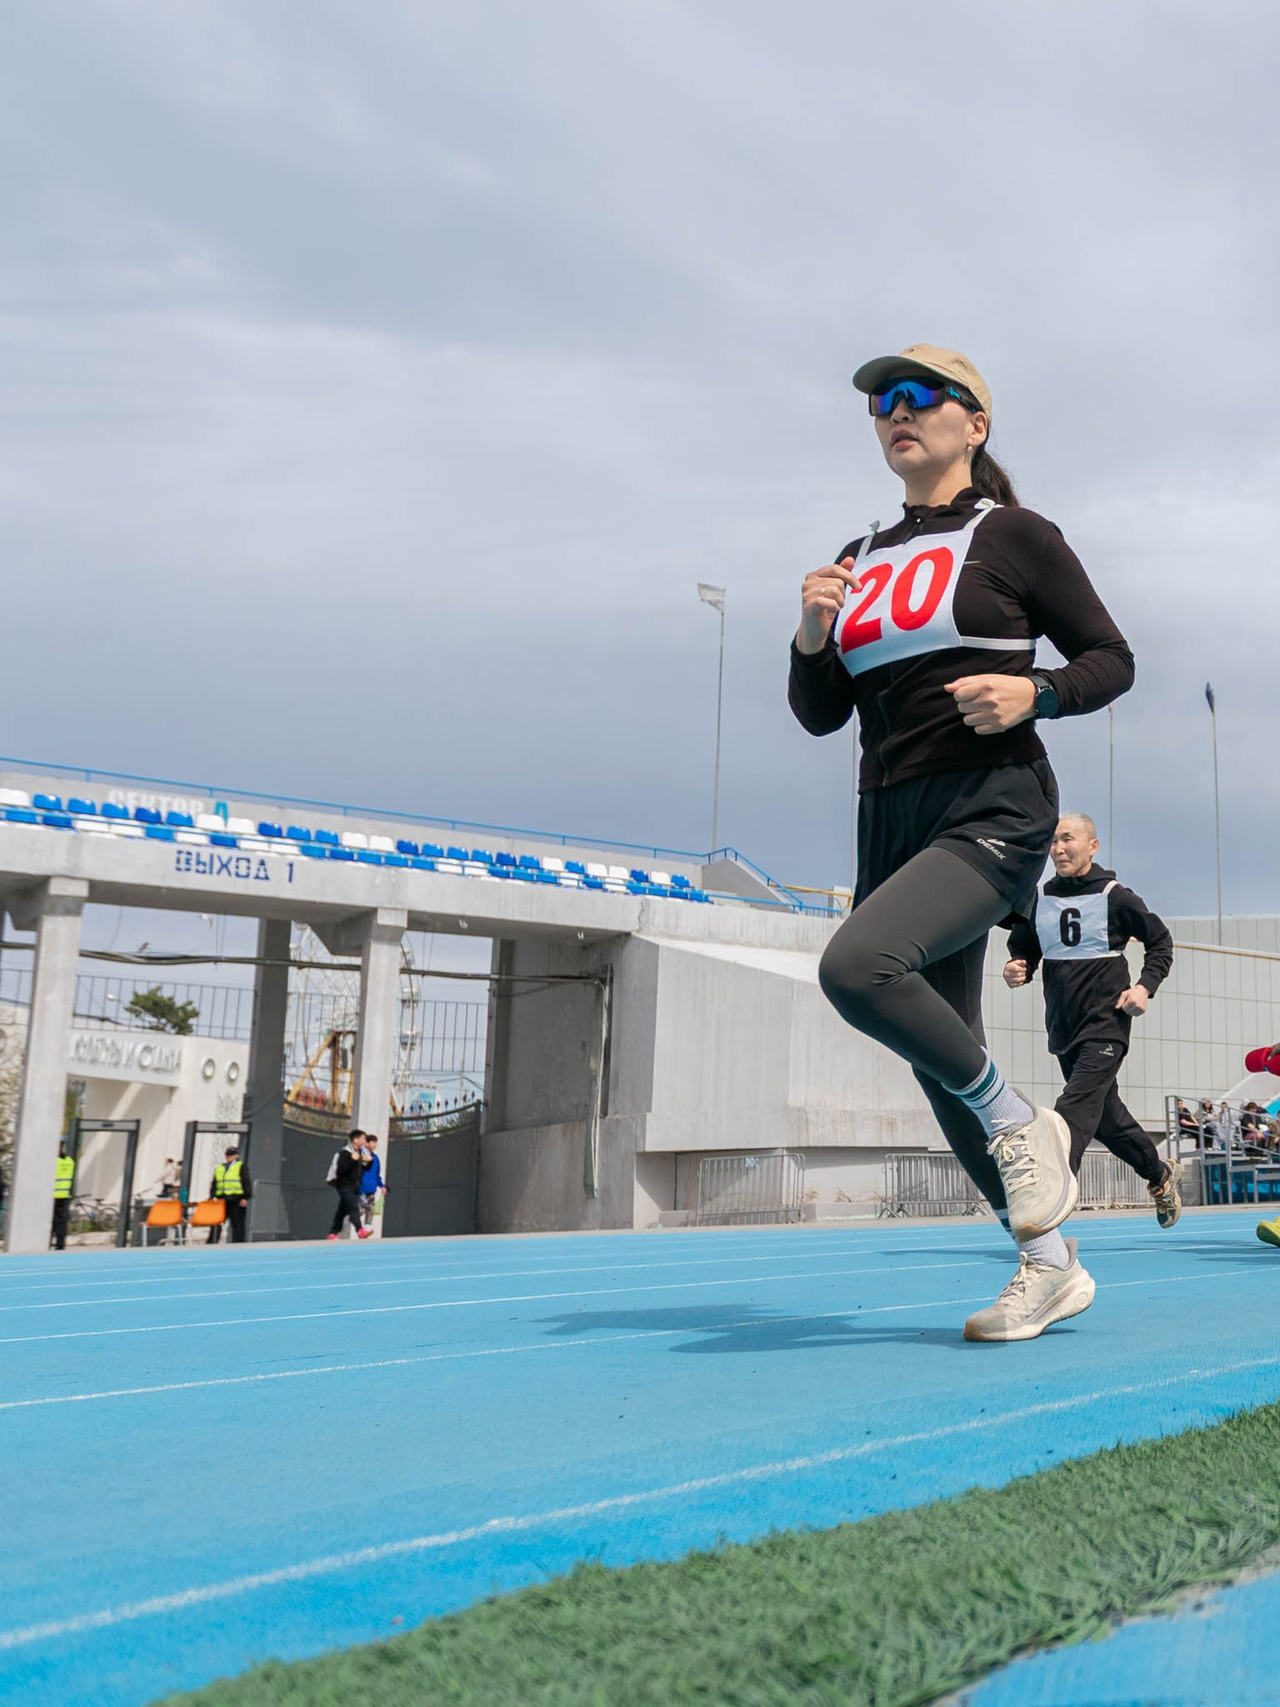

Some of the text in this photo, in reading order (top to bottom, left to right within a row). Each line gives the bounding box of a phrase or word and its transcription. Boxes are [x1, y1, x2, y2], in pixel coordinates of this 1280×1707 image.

[841, 546, 954, 654] 20
[175, 849, 294, 883] ВЫХОД 1
[976, 838, 1006, 860] DEMIX
[1059, 908, 1081, 947] 6
